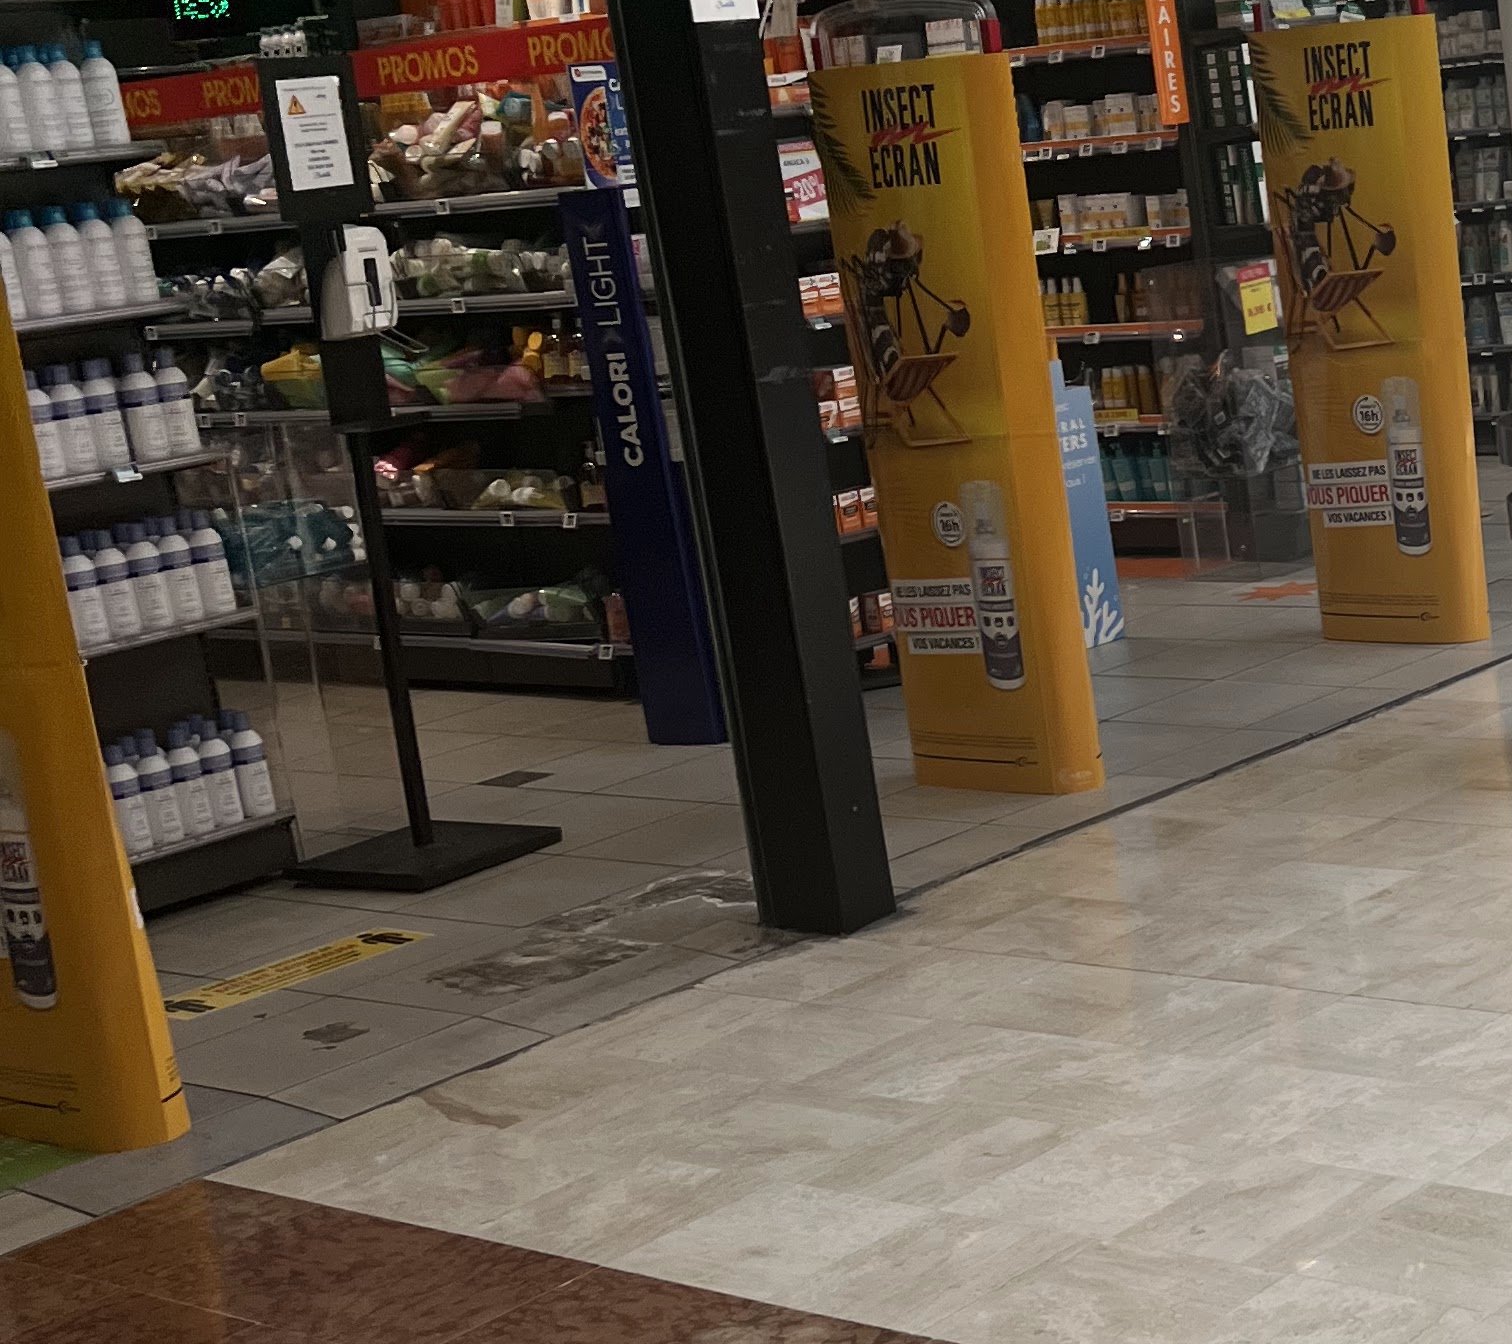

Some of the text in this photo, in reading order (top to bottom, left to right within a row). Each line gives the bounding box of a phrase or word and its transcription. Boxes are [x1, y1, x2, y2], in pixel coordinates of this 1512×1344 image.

[377, 45, 479, 86] PROMOS
[1303, 41, 1371, 84] INSECT
[861, 84, 935, 133] INSECT
[1308, 89, 1374, 131] ECRAN
[869, 141, 941, 188] ECRAN
[583, 236, 622, 326] LIGHT
[606, 352, 645, 467] CALORI
[1360, 410, 1379, 422] 16h
[1322, 467, 1334, 479] LES
[1335, 466, 1367, 479] LAISSEZ
[1368, 464, 1386, 477] PAS
[1337, 484, 1390, 505] PIQUER
[1327, 511, 1342, 523] VOS
[1343, 510, 1387, 523] VACANCES
[953, 583, 972, 596] PAS
[920, 606, 977, 627] PIQUER
[912, 637, 929, 650] VOS
[929, 636, 975, 649] VACANCES
